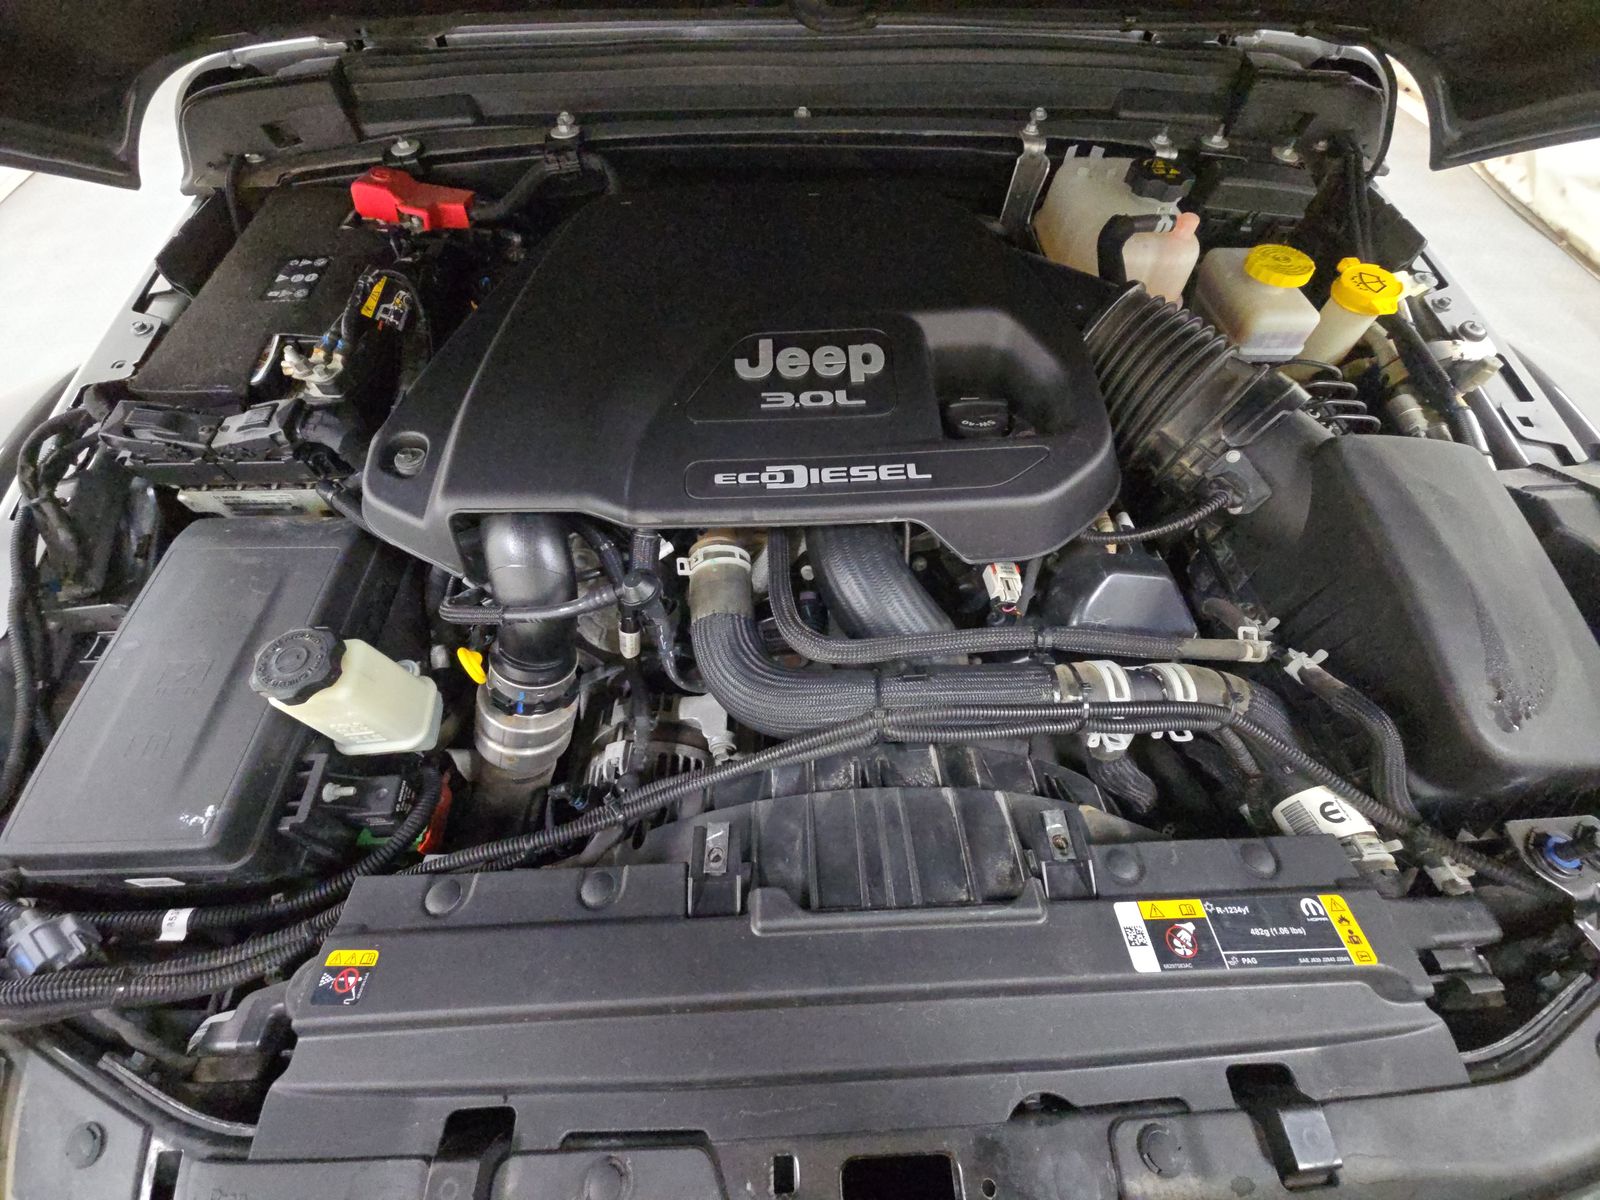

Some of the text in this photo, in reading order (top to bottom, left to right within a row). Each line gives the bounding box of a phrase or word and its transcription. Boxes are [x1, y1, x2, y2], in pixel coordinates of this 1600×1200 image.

[734, 338, 886, 384] Jeep
[760, 389, 867, 408] 3.0L
[1250, 926, 1307, 937] 482g (1.06 lbs)
[1241, 957, 1258, 965] PAG
